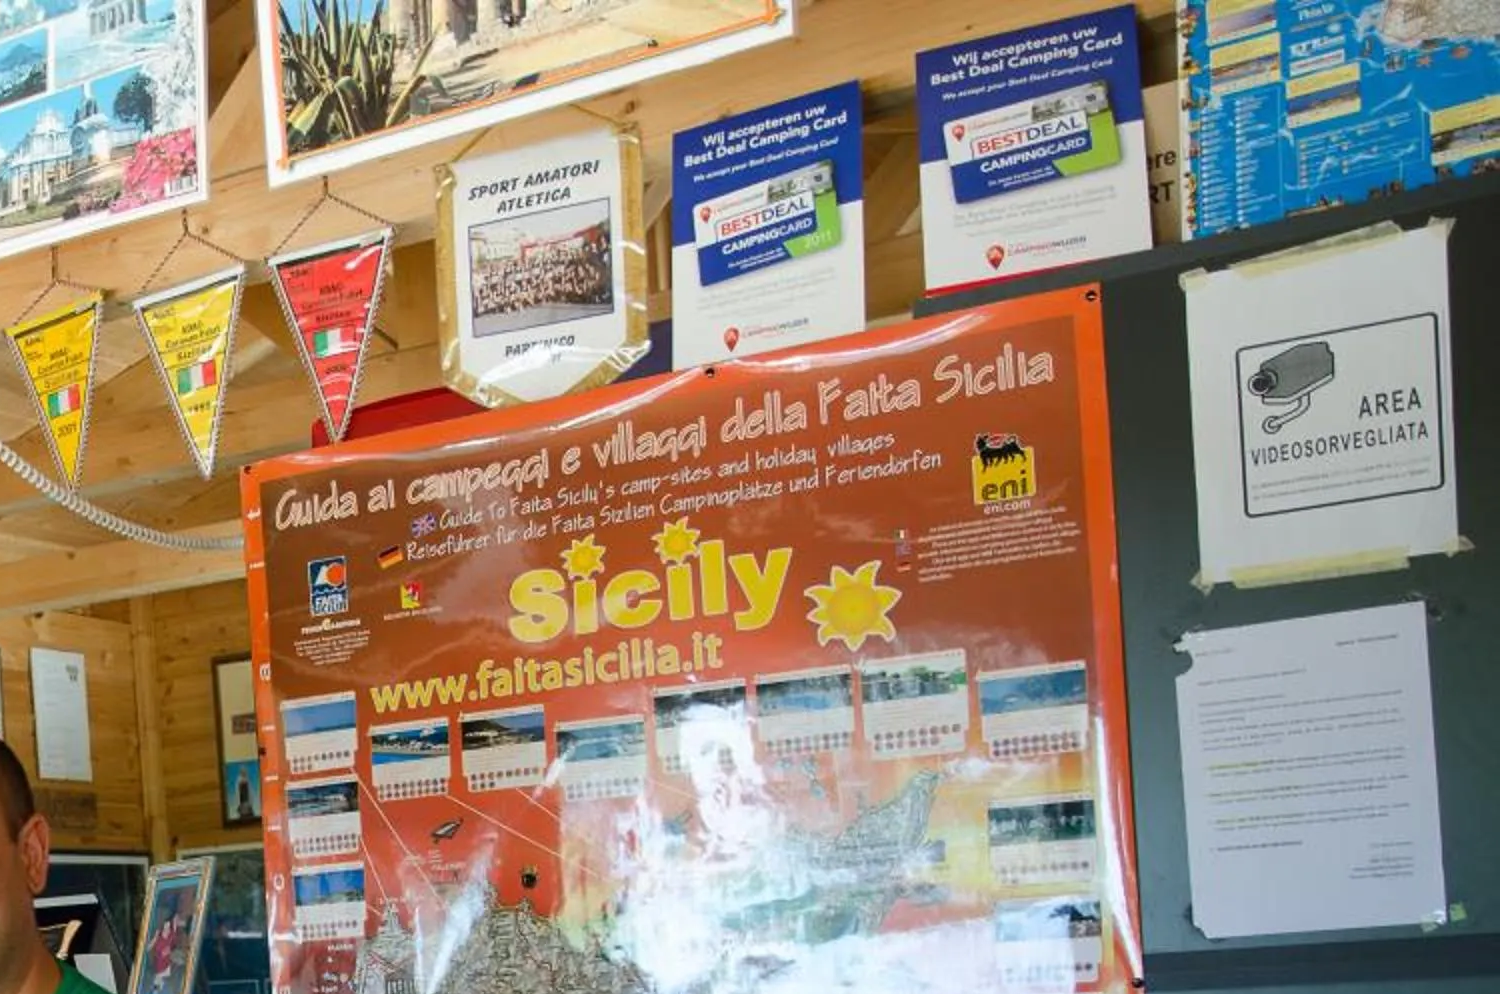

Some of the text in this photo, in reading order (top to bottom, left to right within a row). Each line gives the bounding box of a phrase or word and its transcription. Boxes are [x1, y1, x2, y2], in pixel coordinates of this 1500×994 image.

[930, 32, 1123, 86] Best Deal Camping Card
[981, 33, 1069, 62] accepteren
[1072, 26, 1098, 41] uw
[684, 111, 848, 168] Best Deal Camping Card
[728, 110, 802, 140] accepteren
[805, 104, 828, 119] uw
[468, 159, 601, 202] SPORT AMATORI
[496, 186, 571, 214] ATLETICA
[1358, 387, 1422, 419] AREA
[275, 480, 359, 531] Guida
[405, 447, 550, 505] campeggi
[561, 446, 582, 474] e
[592, 417, 707, 469] villaggi
[719, 392, 808, 445] della
[818, 376, 922, 427] Faita
[932, 342, 1056, 405] Sicilia
[1250, 420, 1430, 467] VIDEOSORVEGLIATA
[439, 504, 483, 530] Guide
[510, 495, 553, 517] Faita
[620, 465, 712, 498] camp-sites
[717, 458, 750, 479] and
[754, 445, 818, 473] holiday
[827, 431, 897, 458] villages
[552, 513, 596, 535] Faita
[789, 470, 820, 493] und
[981, 469, 1029, 502] eni
[509, 528, 793, 646] Sicily
[369, 634, 724, 715] www.faitasicilia.it
